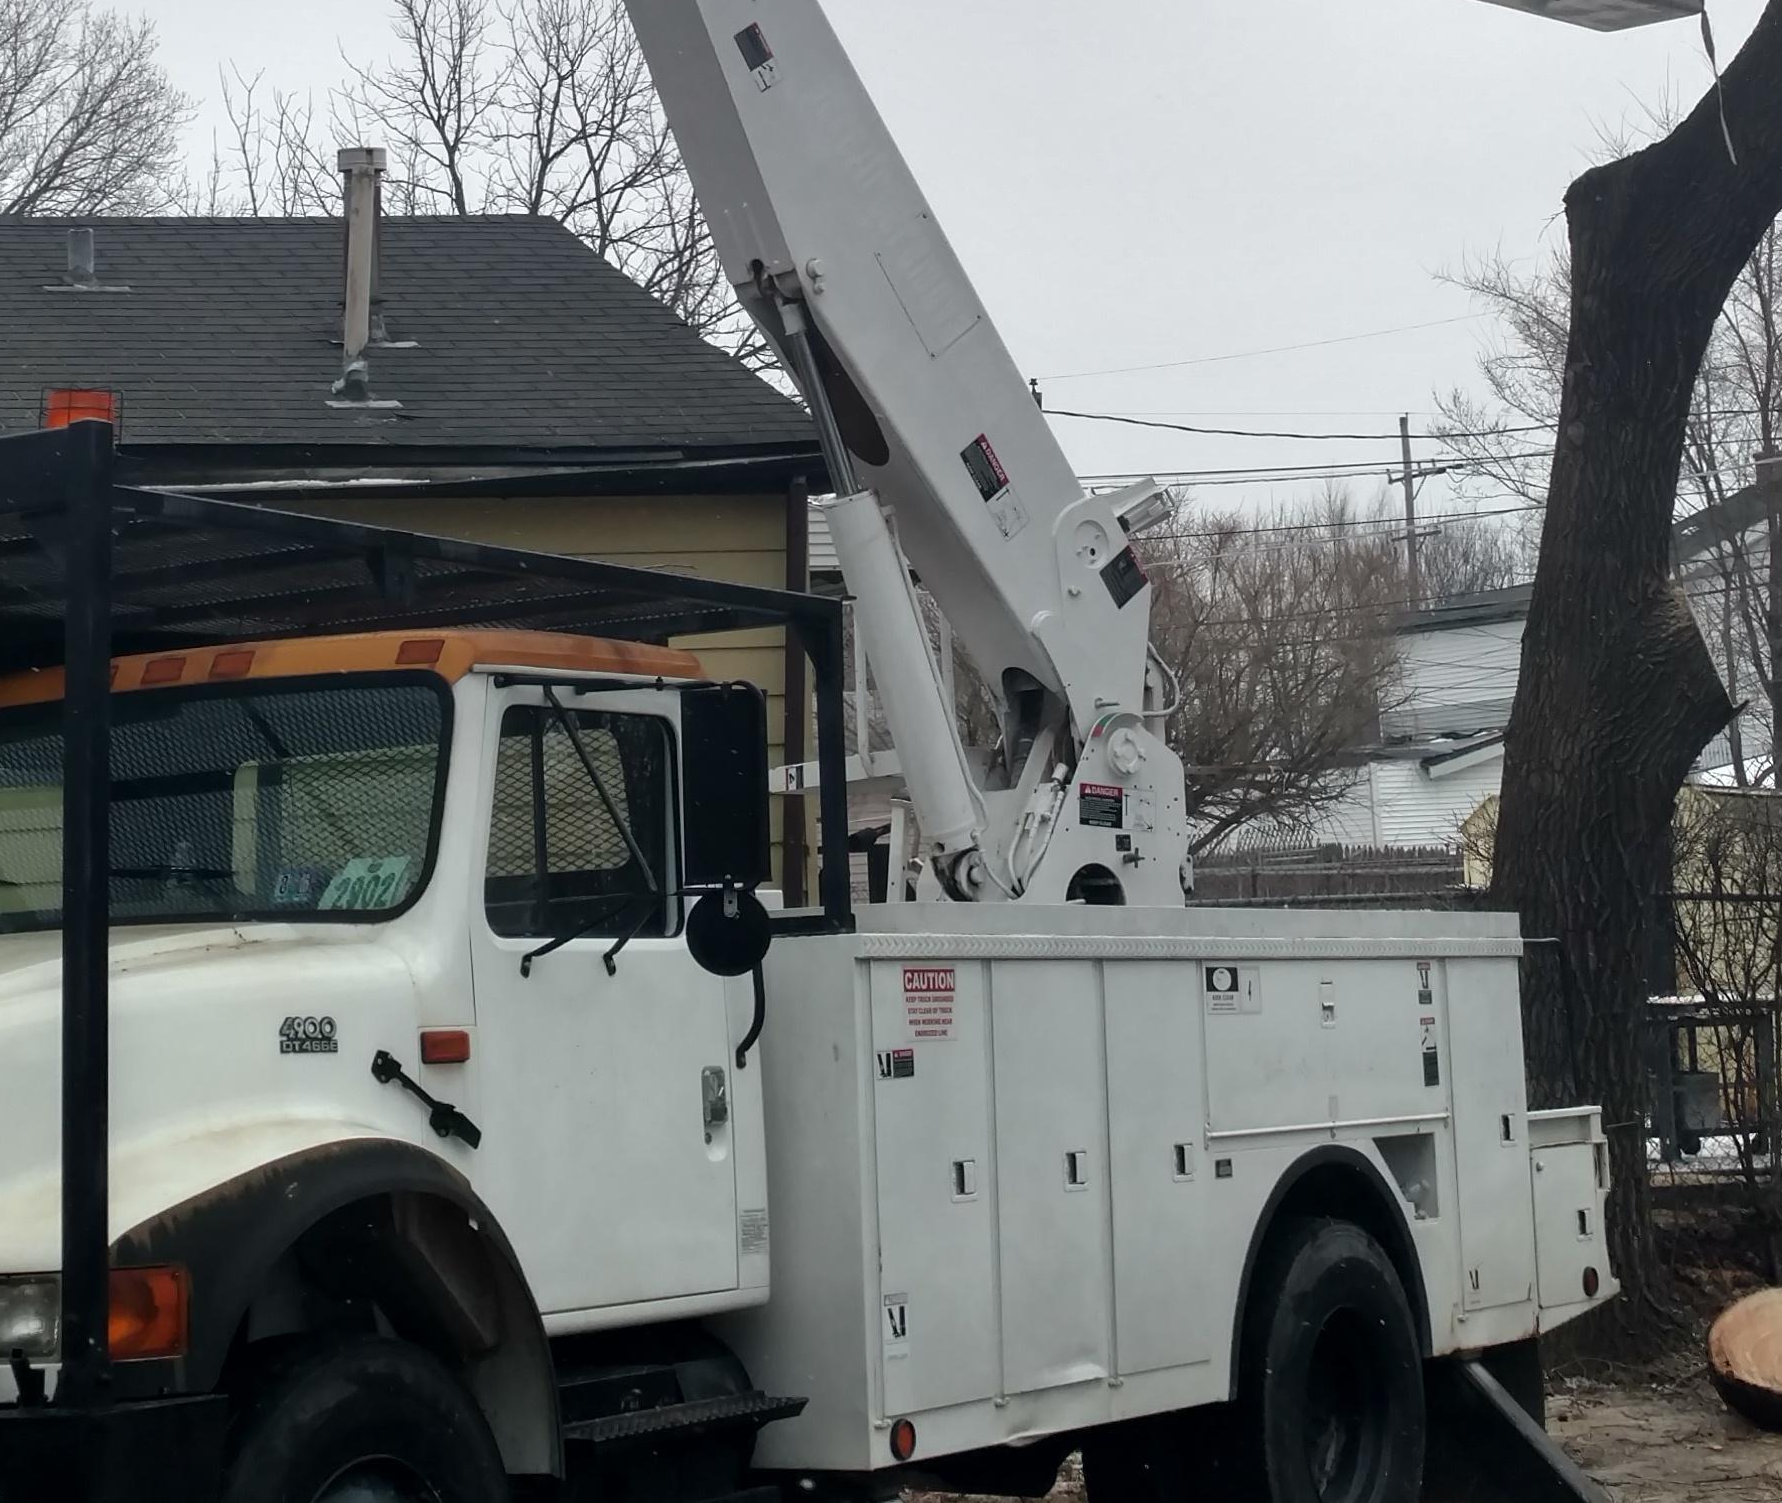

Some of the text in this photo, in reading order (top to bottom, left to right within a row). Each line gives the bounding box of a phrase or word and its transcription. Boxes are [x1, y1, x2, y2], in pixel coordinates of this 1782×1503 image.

[985, 448, 1006, 482] DANGER
[1092, 786, 1119, 796] DANGER
[904, 972, 954, 990] CAUTION
[280, 1016, 337, 1038] 4900
